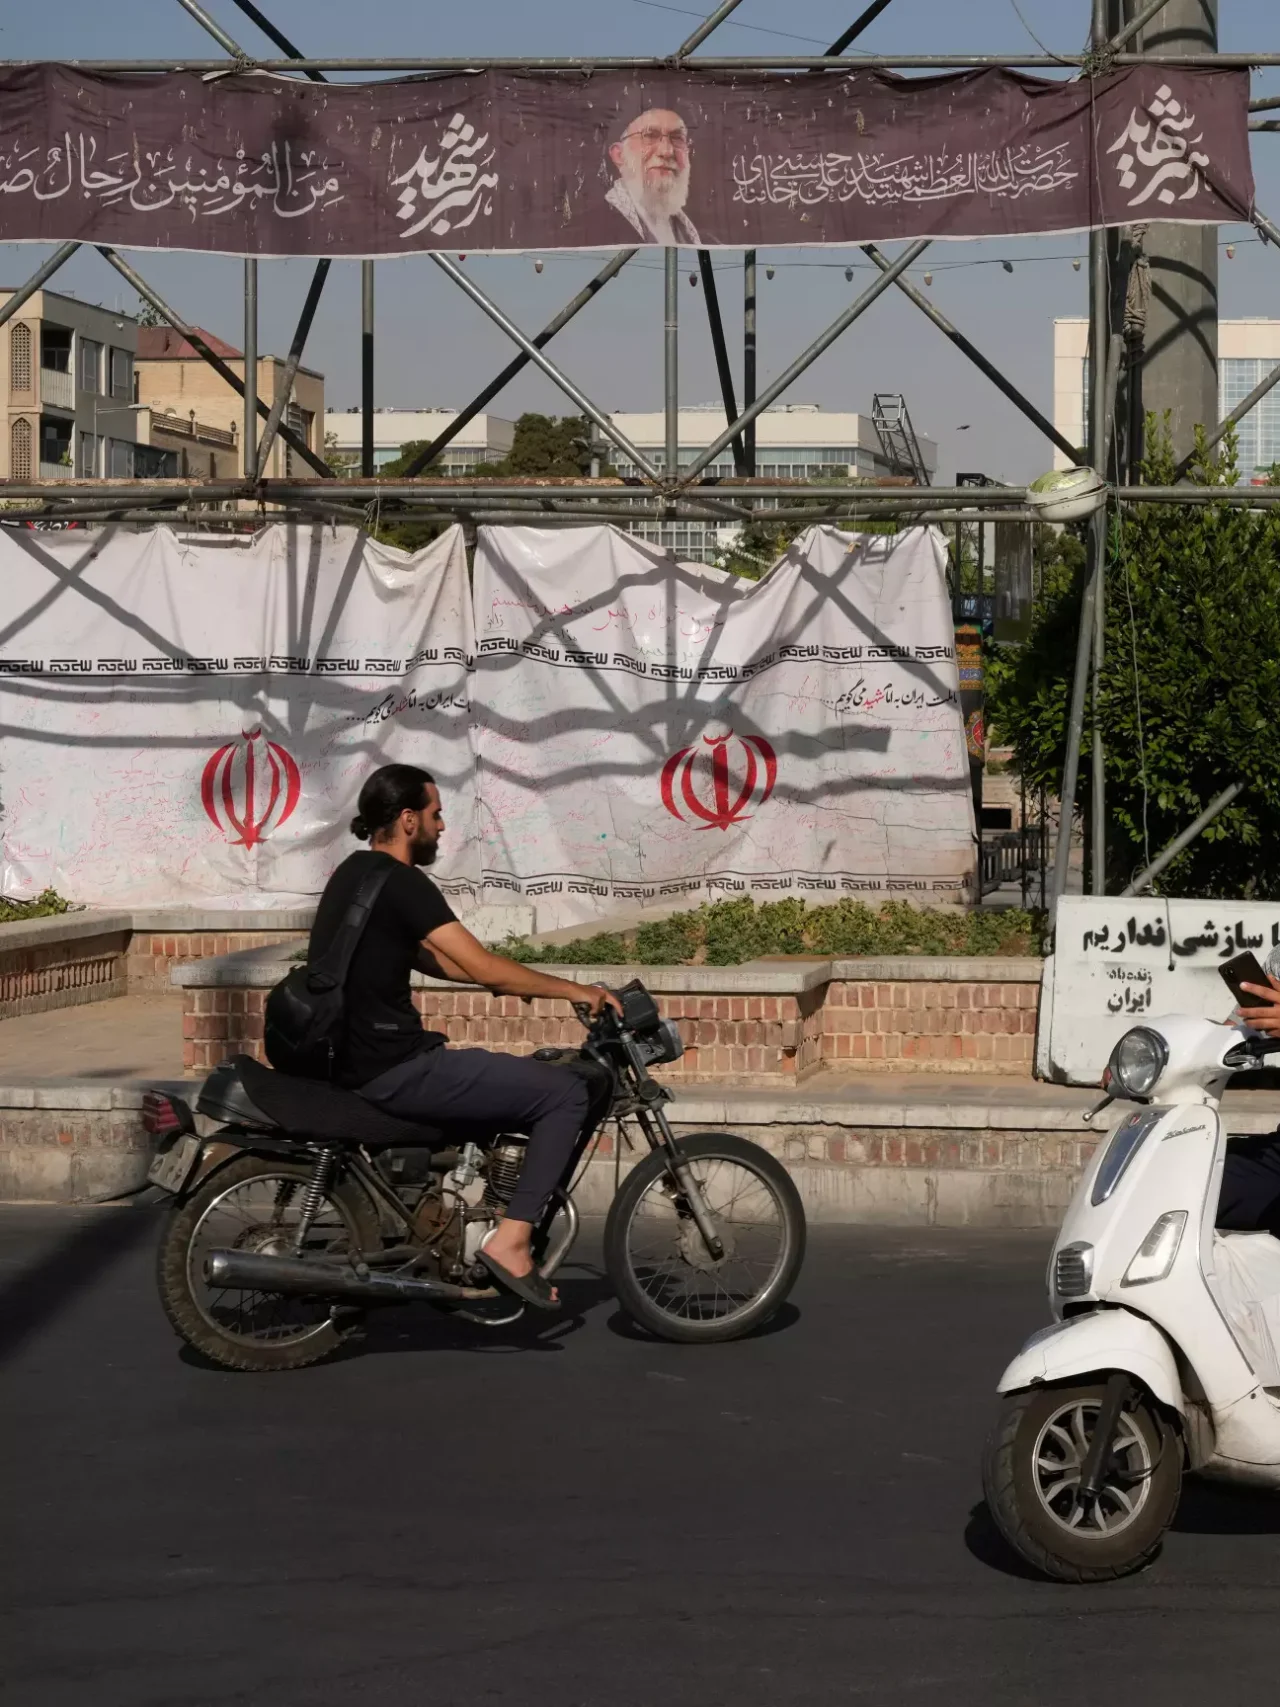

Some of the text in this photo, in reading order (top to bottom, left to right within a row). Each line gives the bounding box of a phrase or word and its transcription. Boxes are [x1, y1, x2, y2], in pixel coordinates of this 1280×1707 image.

[426, 691, 454, 709] ایران
[863, 688, 885, 709] شهید
[901, 688, 925, 708] ایران
[1083, 916, 1167, 952] نداریم
[1172, 919, 1263, 957] سازشی
[1107, 986, 1152, 1014] ایران
